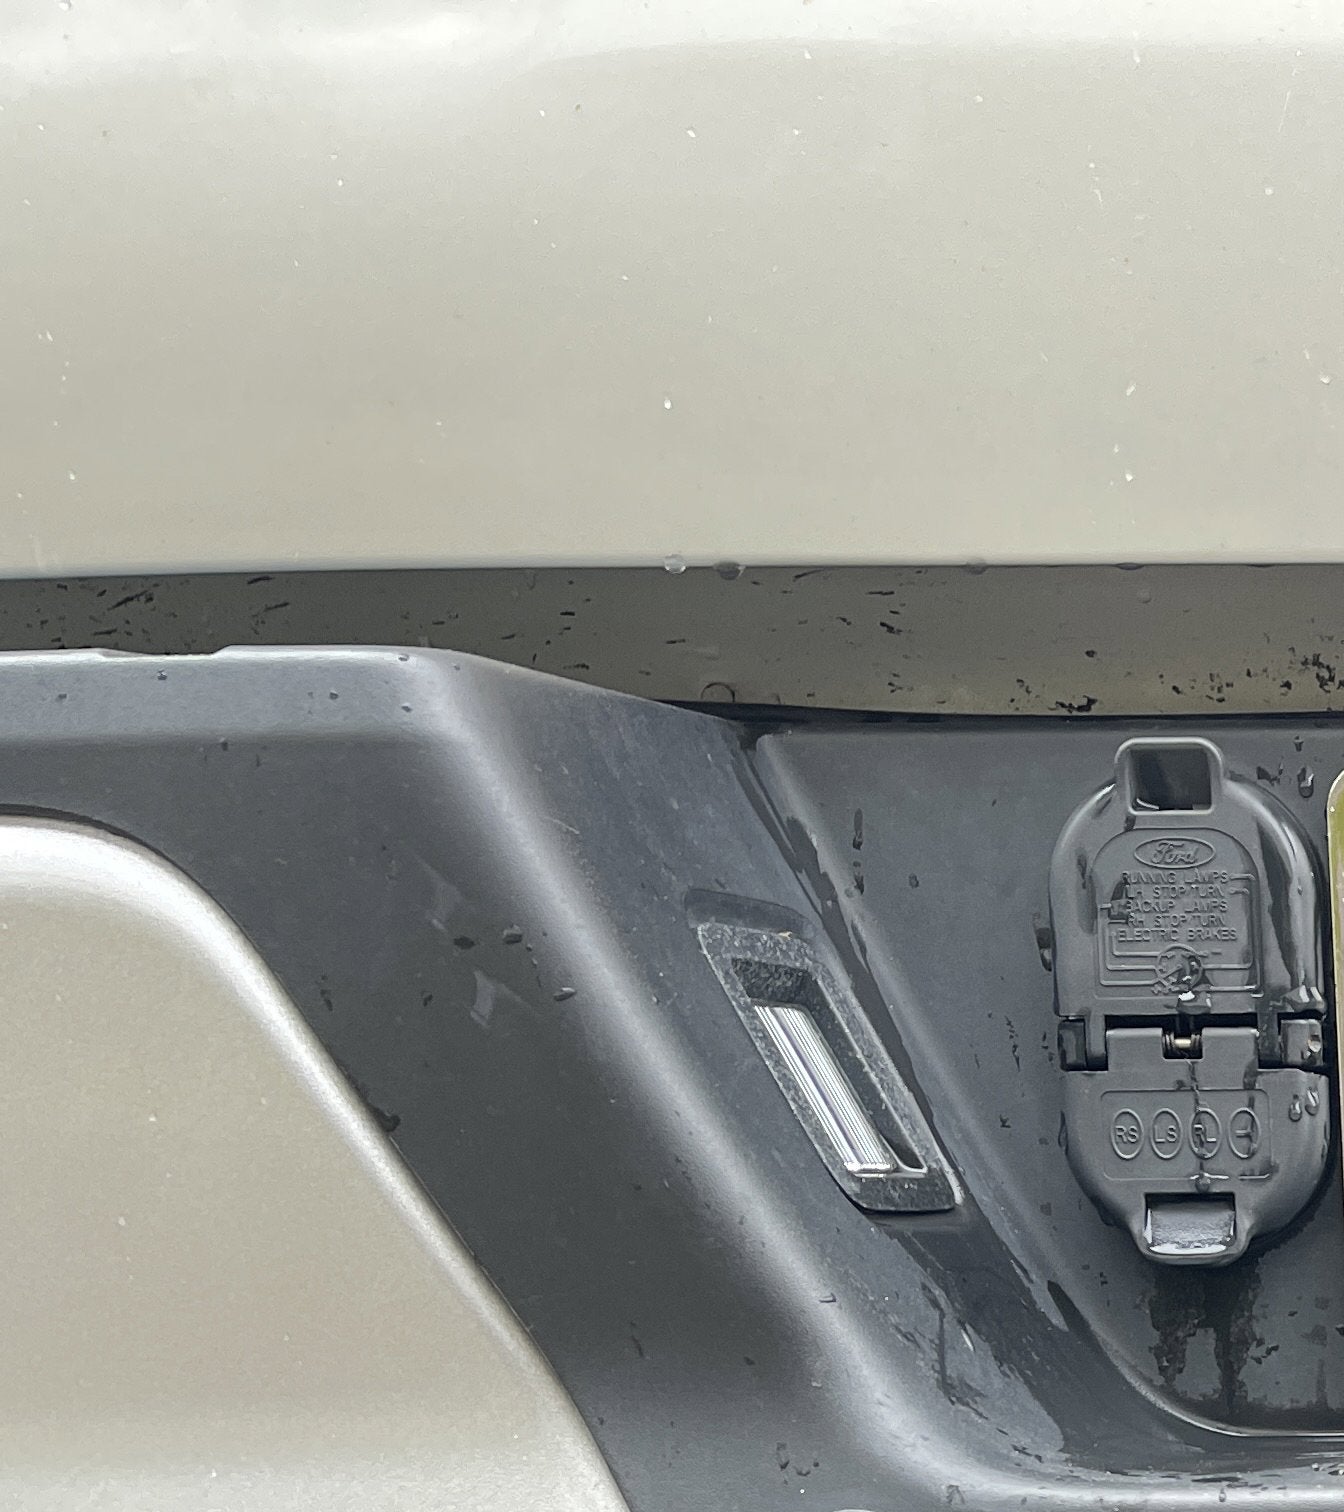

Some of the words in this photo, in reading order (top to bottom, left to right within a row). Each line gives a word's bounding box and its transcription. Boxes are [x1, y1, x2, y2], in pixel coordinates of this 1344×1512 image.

[1151, 839, 1200, 864] Ford
[1121, 870, 1177, 885] RUNNING
[1184, 870, 1229, 884] LAMPS
[1125, 899, 1177, 914] BACKUP
[1184, 899, 1229, 914] LAMPS
[1127, 913, 1145, 928] RH
[1117, 927, 1179, 943] ELECTRIC
[1187, 927, 1238, 943] BRAKES
[1114, 1124, 1139, 1144] RS
[1154, 1124, 1178, 1143] LS
